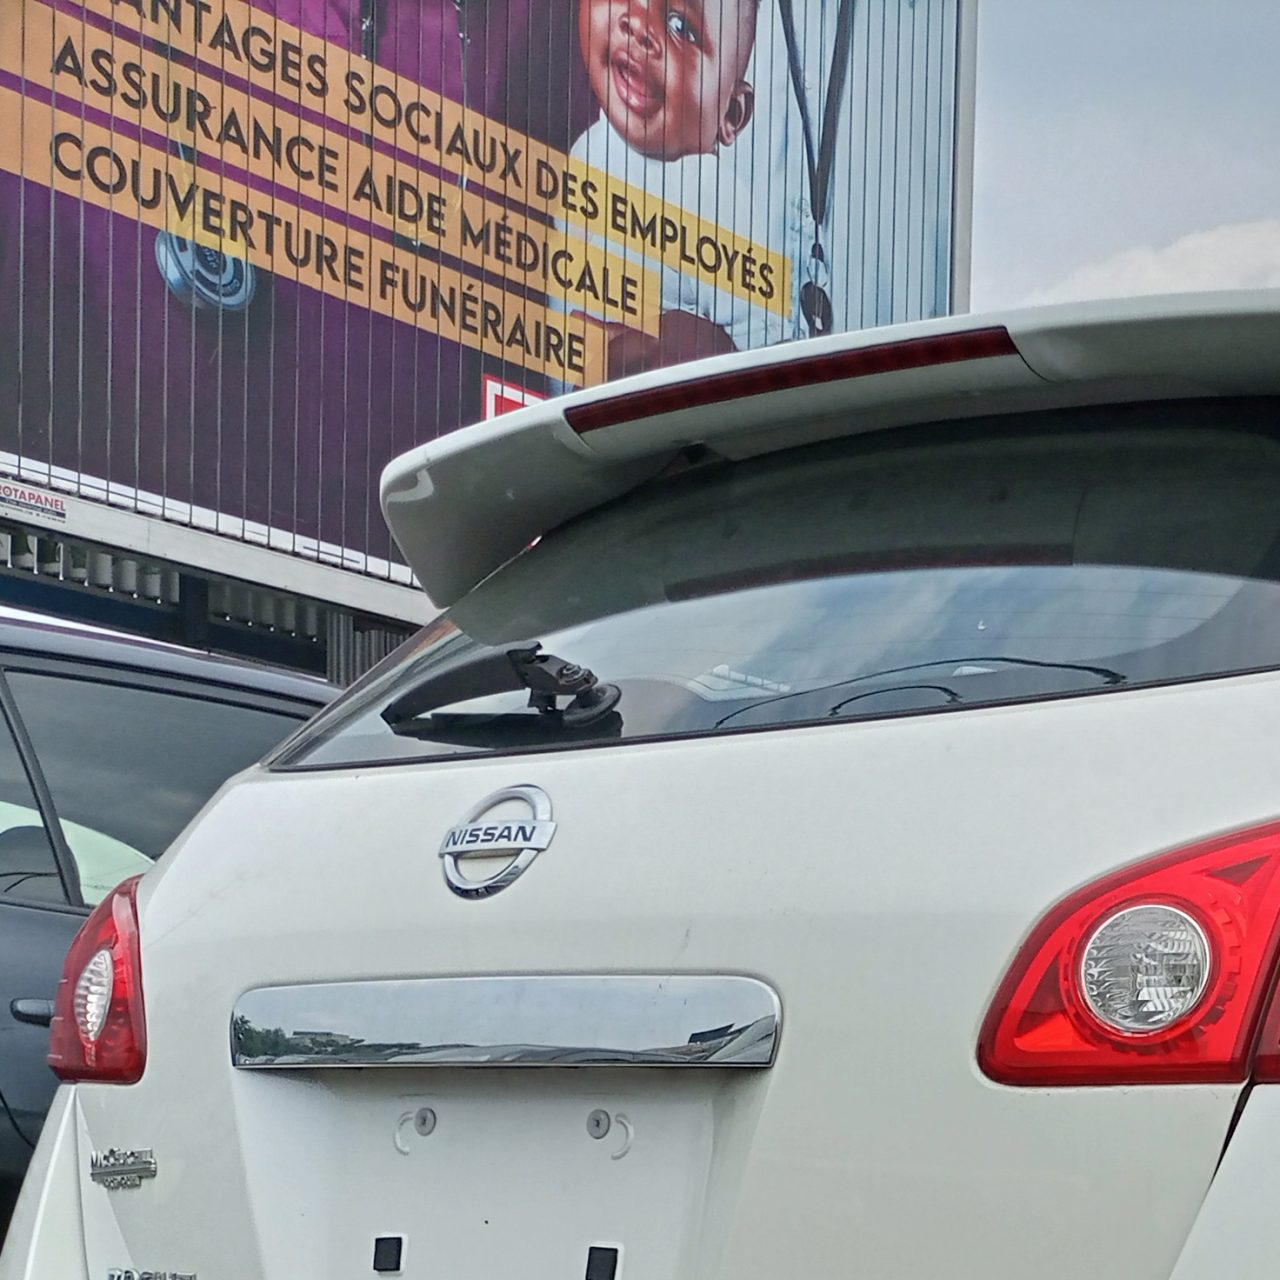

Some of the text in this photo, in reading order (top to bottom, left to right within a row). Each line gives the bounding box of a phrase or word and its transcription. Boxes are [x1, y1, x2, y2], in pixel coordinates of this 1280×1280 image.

[50, 35, 638, 316] ASSURANCE AIDE MÉDICALE
[50, 132, 586, 374] COUVERTURE FUNÉRAIRE
[343, 71, 522, 189] SOCIAUX
[536, 158, 599, 221] DES
[611, 192, 775, 300] EMPLOYÉS
[445, 825, 537, 848] NISSAN
